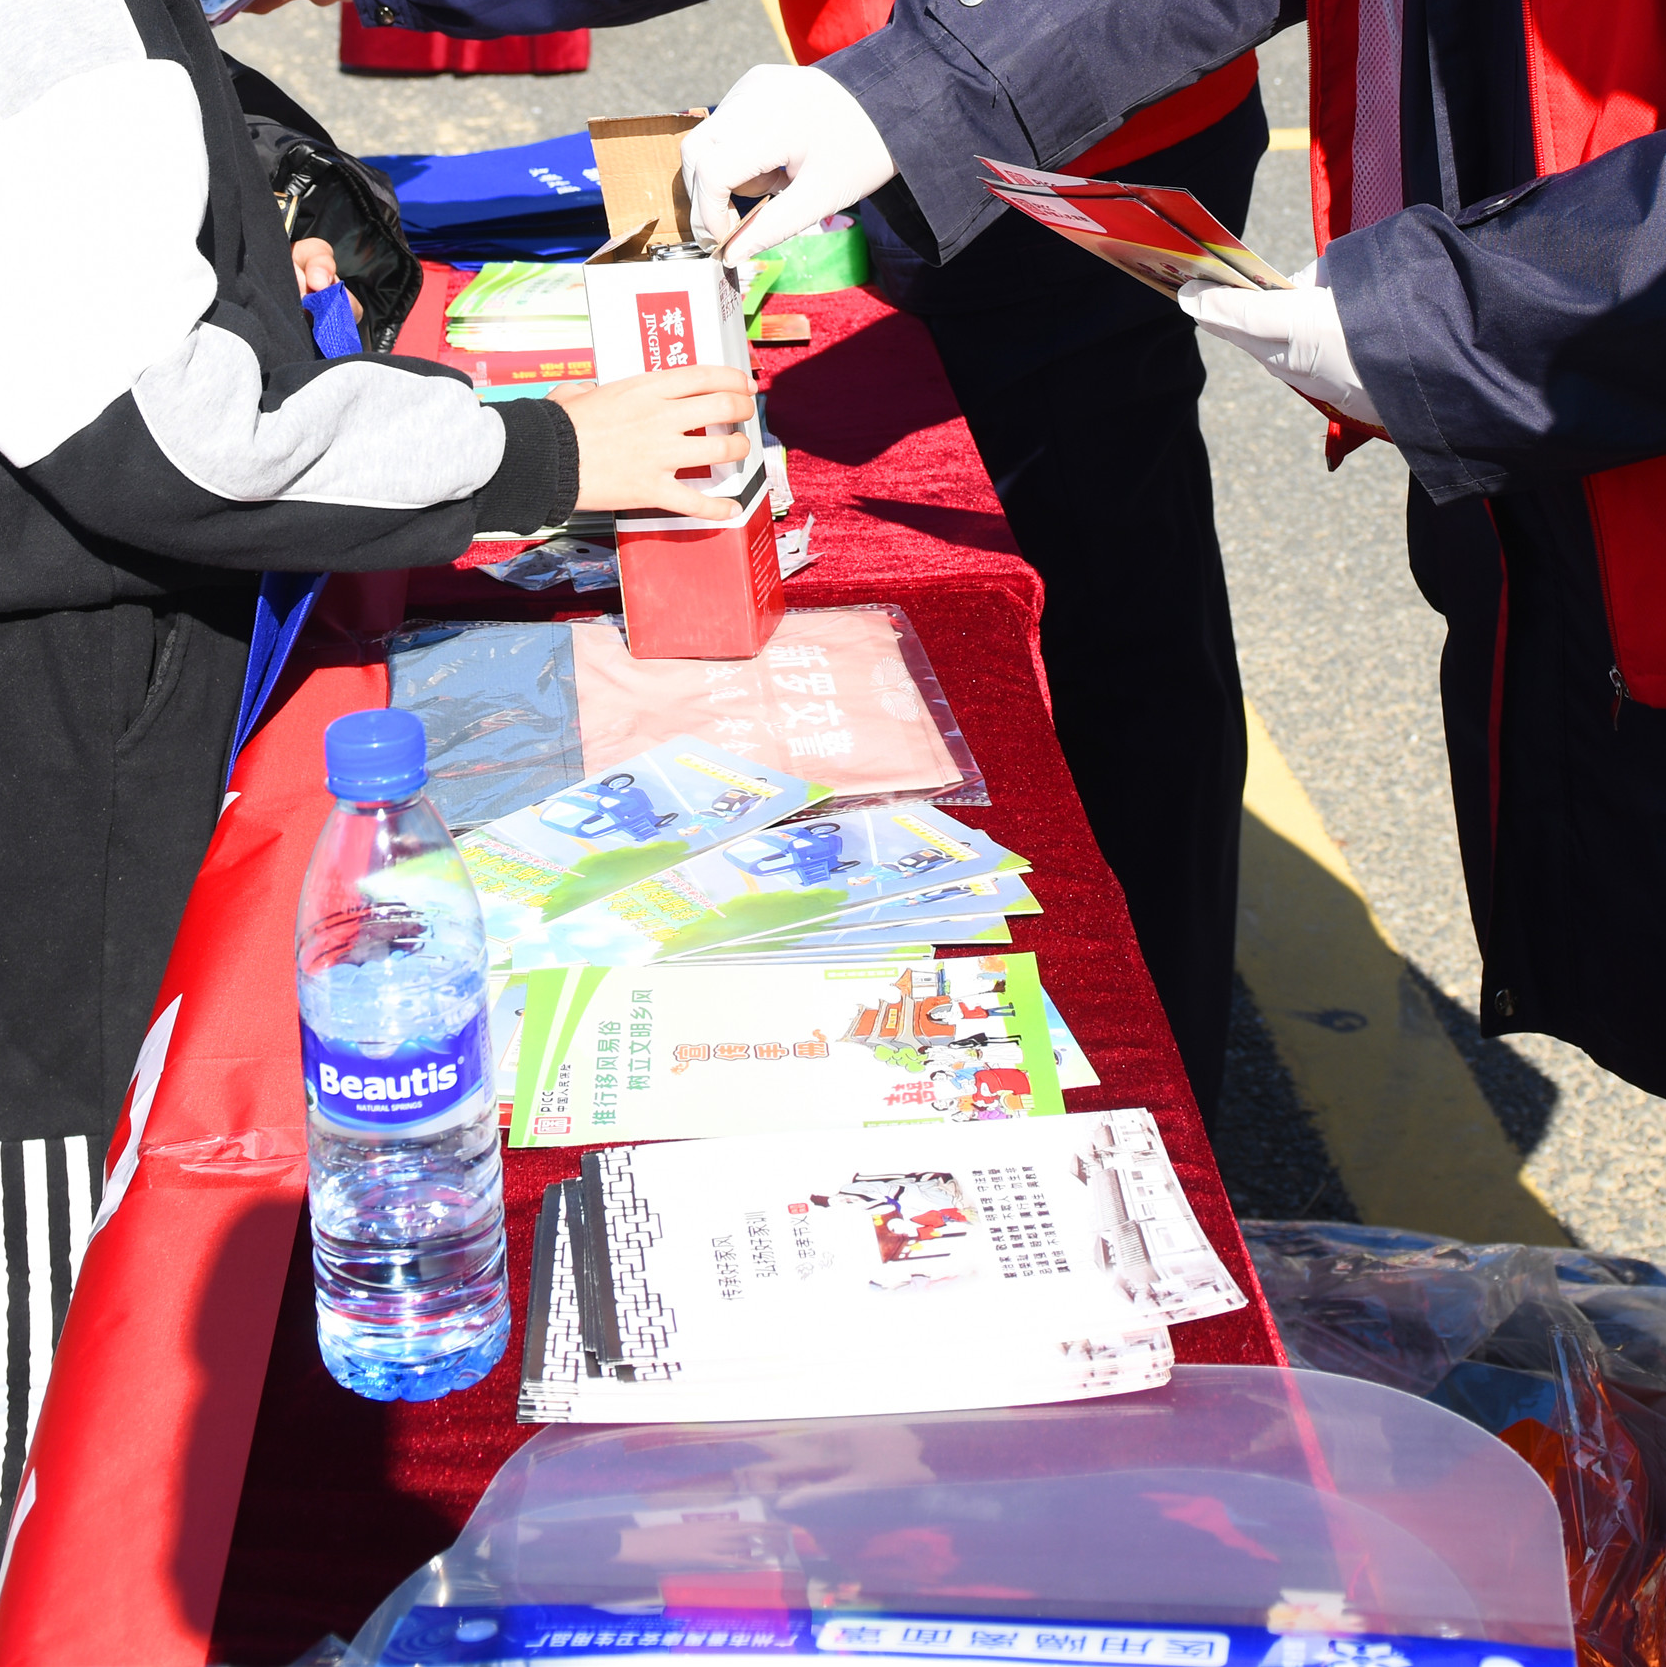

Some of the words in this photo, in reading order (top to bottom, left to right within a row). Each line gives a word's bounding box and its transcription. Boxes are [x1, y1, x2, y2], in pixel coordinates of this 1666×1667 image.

[659, 307, 689, 367] 精品
[768, 644, 855, 759] 新罗交警
[626, 988, 654, 1091] 树立文明乡风
[672, 1041, 830, 1063] 宣传手册
[319, 1062, 458, 1101] Beautis
[556, 1063, 572, 1113] 中国人民保险
[592, 1019, 622, 1126] 推行移风易俗
[356, 1102, 390, 1113] NATURAL
[391, 1100, 423, 1112] SPRINGS
[539, 1090, 555, 1114] PICC
[744, 1210, 779, 1279] 弘扬好家训
[789, 1214, 817, 1260] 忠孝节义
[712, 1233, 743, 1302] 传承好家风
[835, 1626, 1215, 1660] 医用隔离面罩
